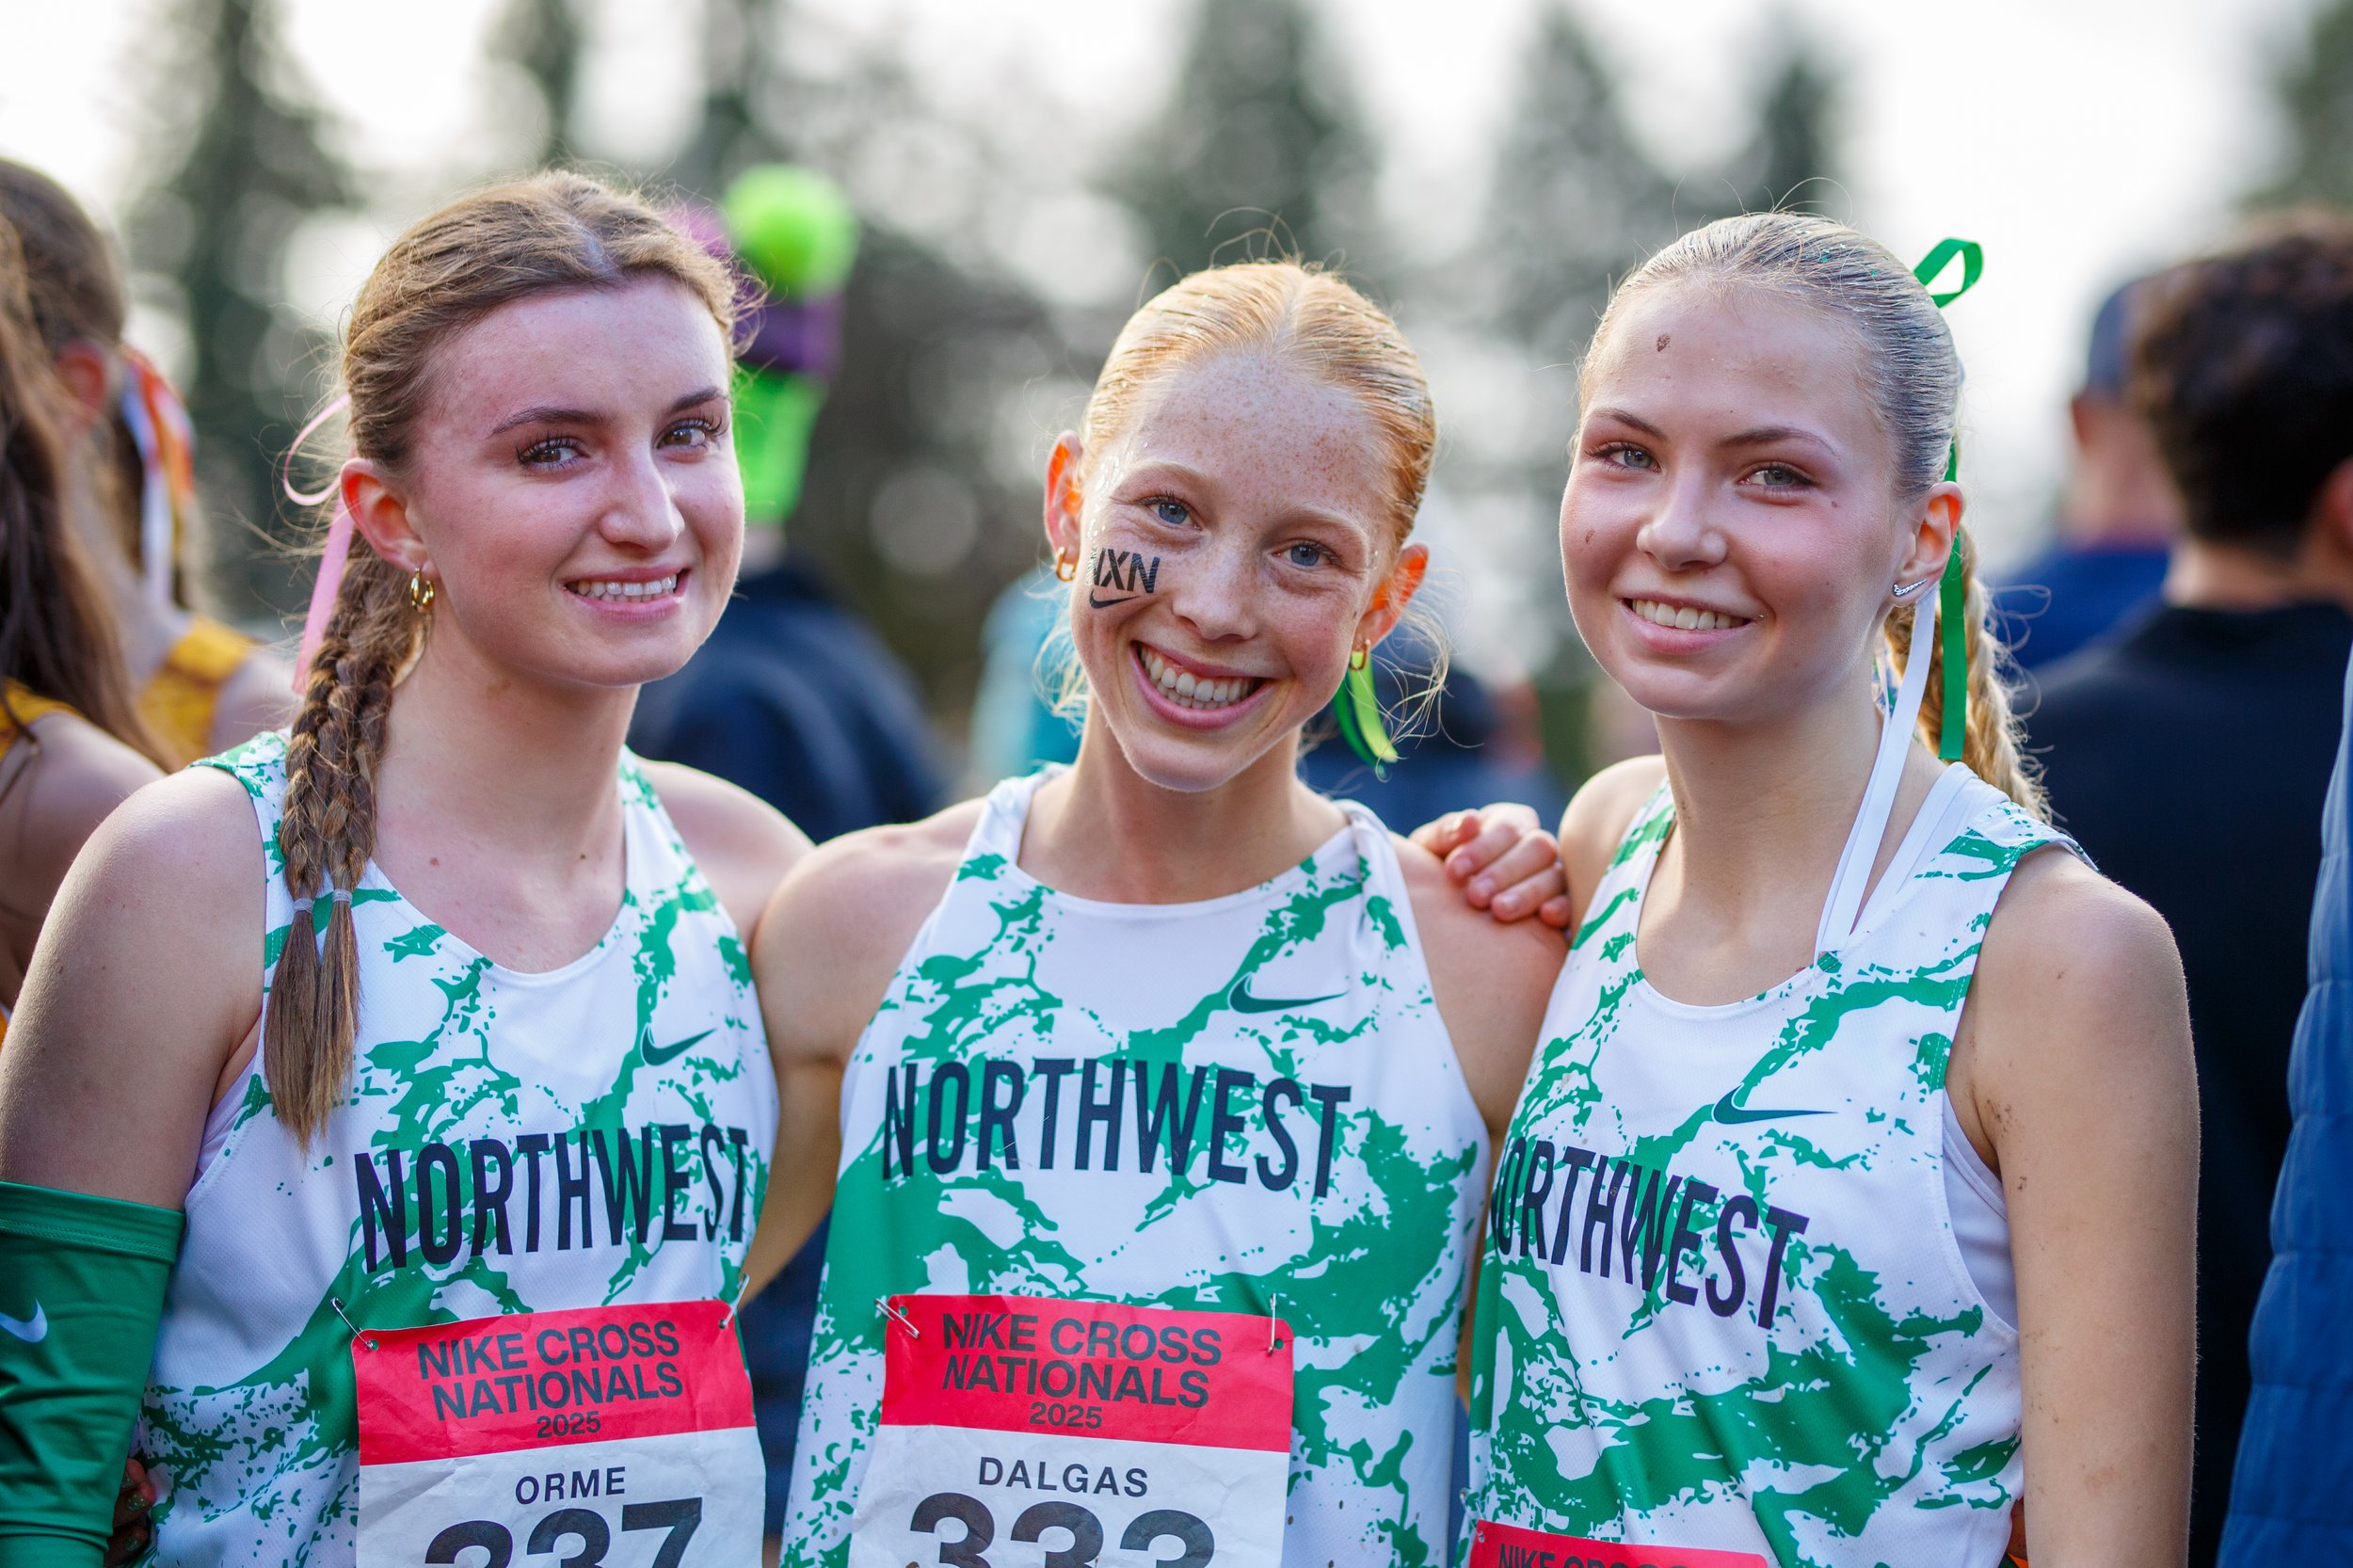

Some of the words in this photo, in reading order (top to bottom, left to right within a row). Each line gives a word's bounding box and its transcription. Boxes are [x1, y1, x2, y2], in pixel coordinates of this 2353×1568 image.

[882, 1058, 1352, 1199] NORTHWEST
[354, 1123, 749, 1273] NORTHWEST
[1491, 1136, 1811, 1330] ORTHWEST
[417, 1332, 528, 1380] NIKE
[536, 1320, 680, 1366] CROSS
[942, 1313, 1039, 1352] NIKE
[1049, 1318, 1222, 1367] CROSS
[432, 1361, 683, 1422] NATIONALS
[942, 1353, 1209, 1409] NATIONALS
[536, 1411, 601, 1438] 2025
[1029, 1401, 1102, 1430] 2025
[515, 1466, 626, 1505] ORME
[979, 1456, 1148, 1498] DALGAS
